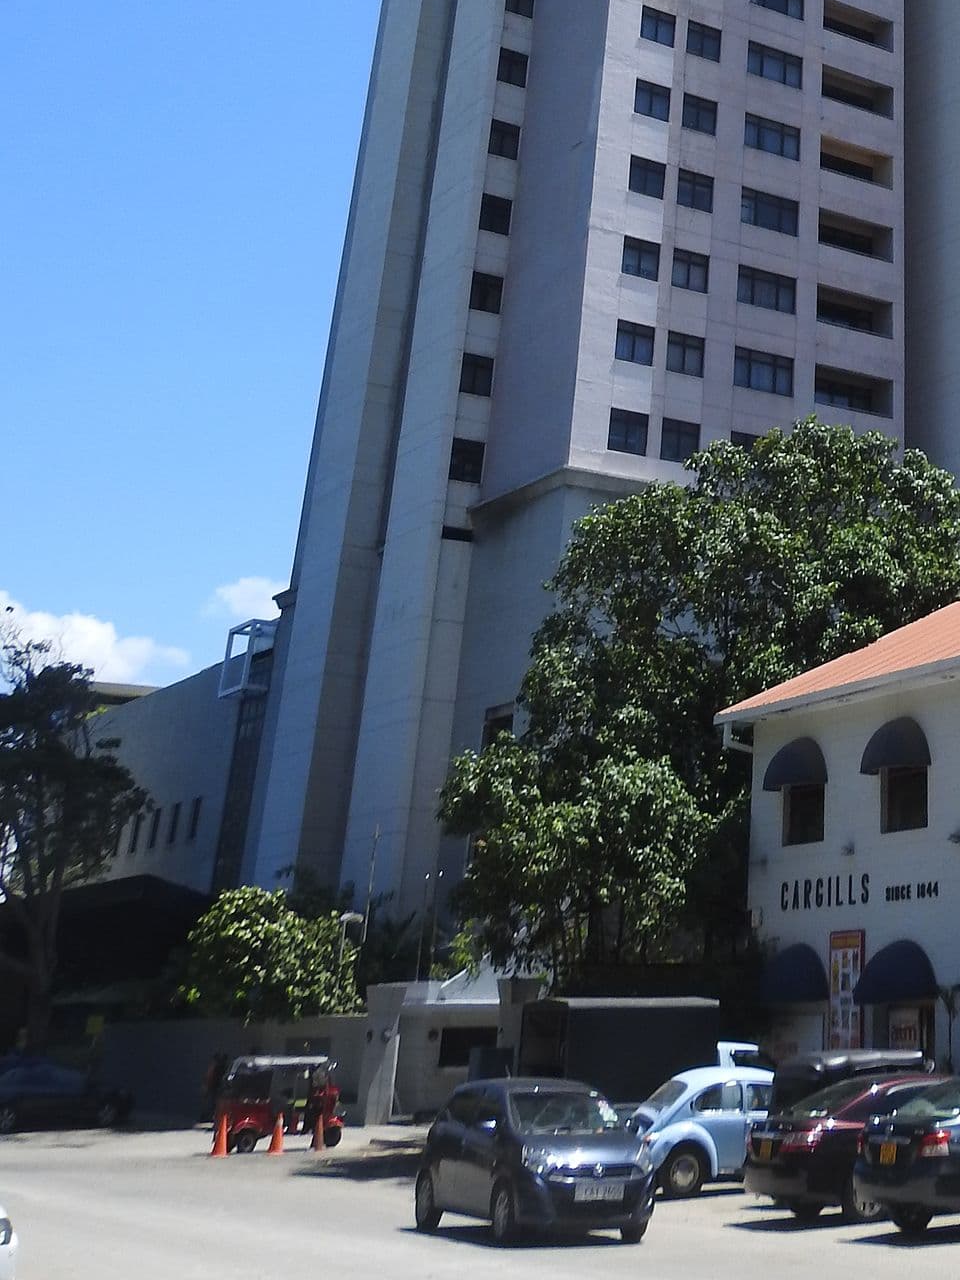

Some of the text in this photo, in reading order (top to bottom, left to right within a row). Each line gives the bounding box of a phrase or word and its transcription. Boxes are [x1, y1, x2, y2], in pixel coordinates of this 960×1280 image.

[780, 873, 939, 911] CARGILLS SINCE 1844
